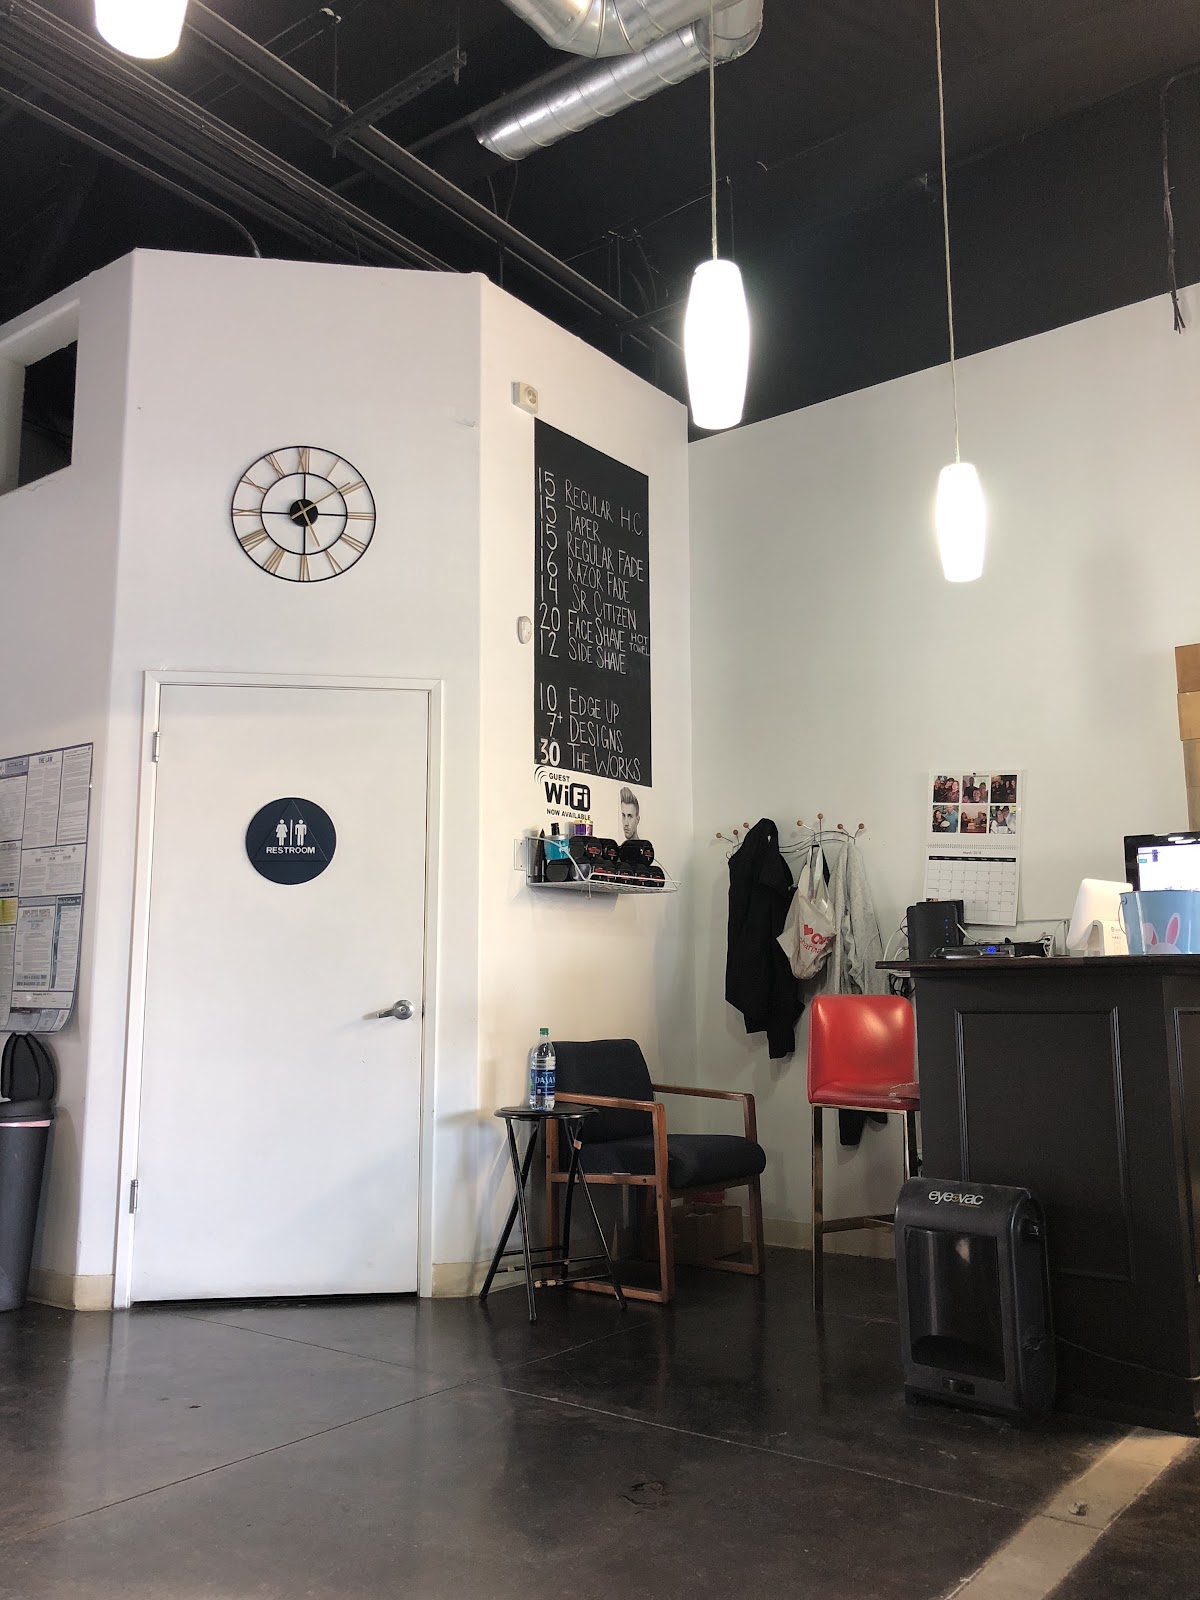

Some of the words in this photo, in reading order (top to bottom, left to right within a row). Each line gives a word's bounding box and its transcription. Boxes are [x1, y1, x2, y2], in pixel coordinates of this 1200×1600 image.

[539, 467, 556, 497] 15
[565, 479, 614, 523] REGULAR
[620, 506, 644, 536] H.C.
[540, 494, 557, 524] 15
[565, 505, 601, 544] TAPER
[541, 520, 558, 551] 15
[567, 531, 614, 571] REGULAR
[618, 549, 644, 582] FADE
[541, 547, 558, 577] 16
[567, 557, 604, 591] RAZOR
[607, 571, 631, 603] FADE
[541, 574, 559, 605] 14
[572, 583, 591, 614] SR
[593, 591, 637, 630] CITIZEN
[539, 602, 561, 632] 20
[568, 609, 594, 643] FACE
[595, 617, 626, 652] SHAVE
[630, 632, 648, 645] HOT
[540, 629, 559, 658] 12
[568, 637, 593, 664] SIDE
[596, 645, 627, 674] SHAVE
[628, 642, 650, 656] TOWEL
[540, 682, 557, 712] 10
[569, 687, 601, 720] EDGE
[605, 699, 620, 724] UP
[569, 715, 624, 753] DESIGNS
[540, 738, 561, 767] 30
[567, 742, 591, 772] THE
[593, 746, 641, 781] WORKS
[548, 772, 571, 783] GUEST
[544, 781, 591, 812] WiFi
[546, 808, 560, 817] NOW
[561, 811, 591, 821] AVAILABLE
